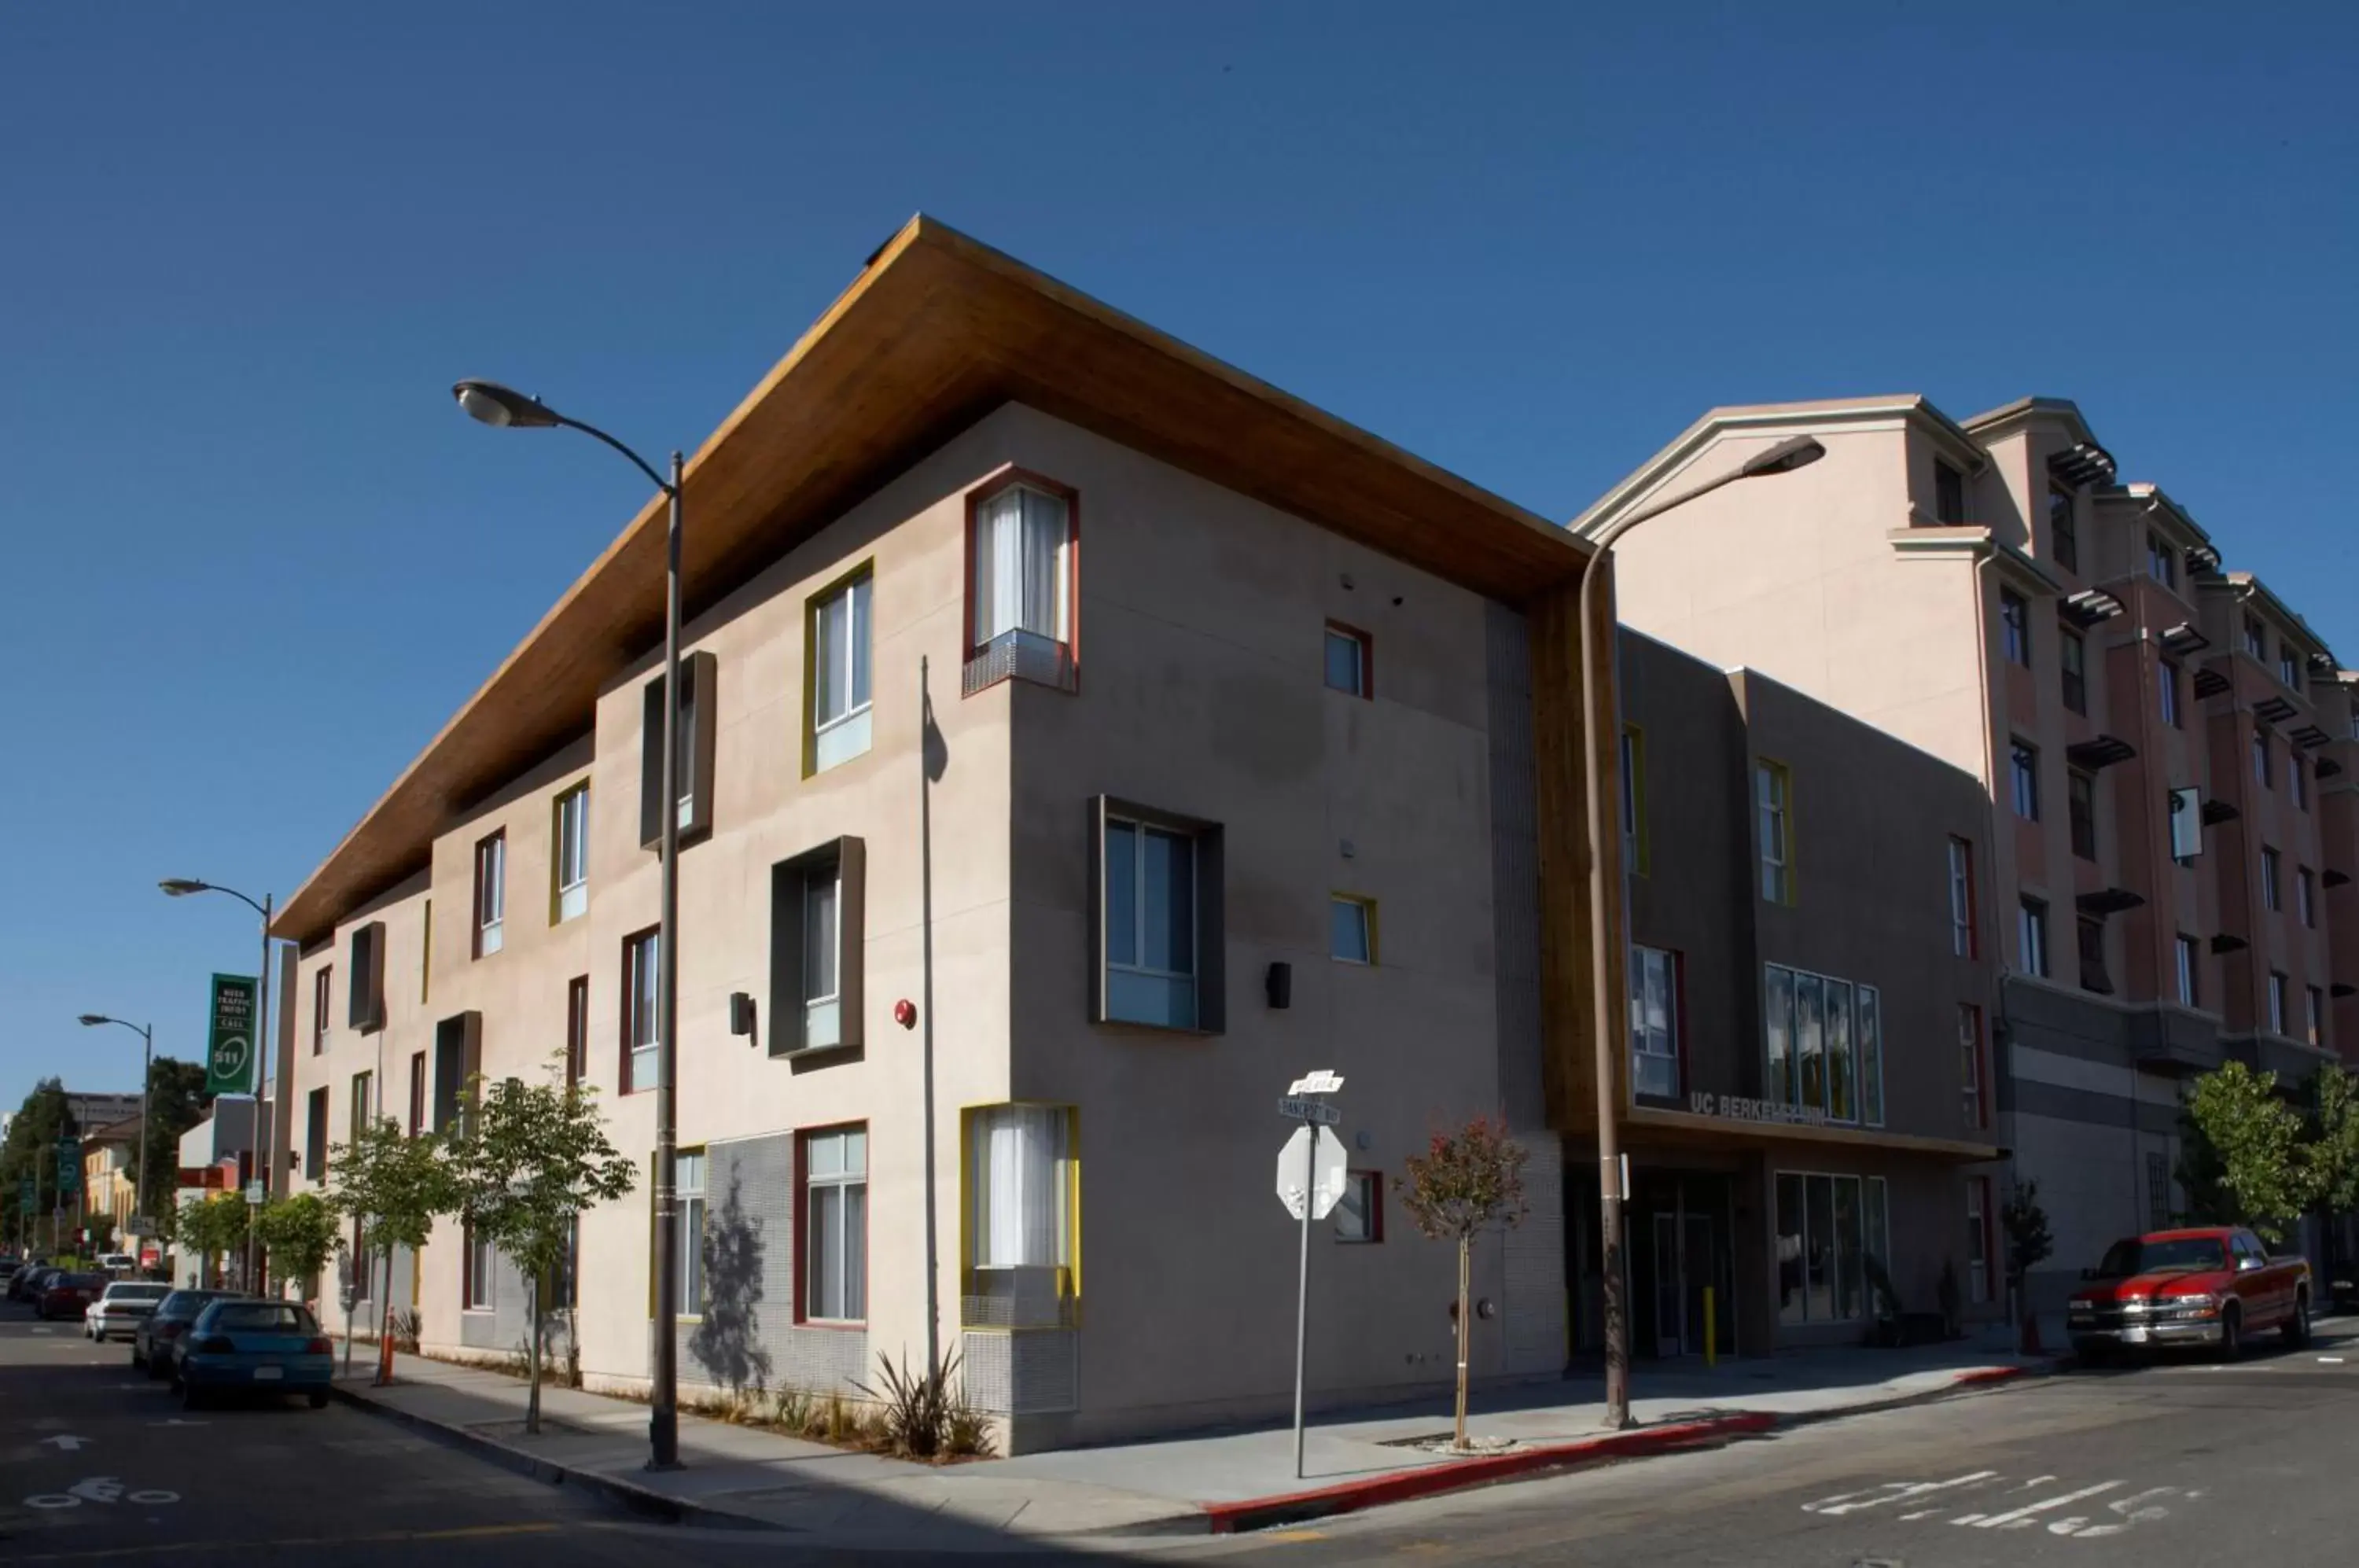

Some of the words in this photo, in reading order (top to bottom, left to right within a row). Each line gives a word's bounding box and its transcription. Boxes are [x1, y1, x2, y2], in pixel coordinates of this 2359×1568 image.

[221, 1018, 243, 1028] CALL
[214, 1050, 238, 1064] 511
[1691, 1091, 1714, 1113] UC
[1720, 1095, 1798, 1124] BERKELEY
